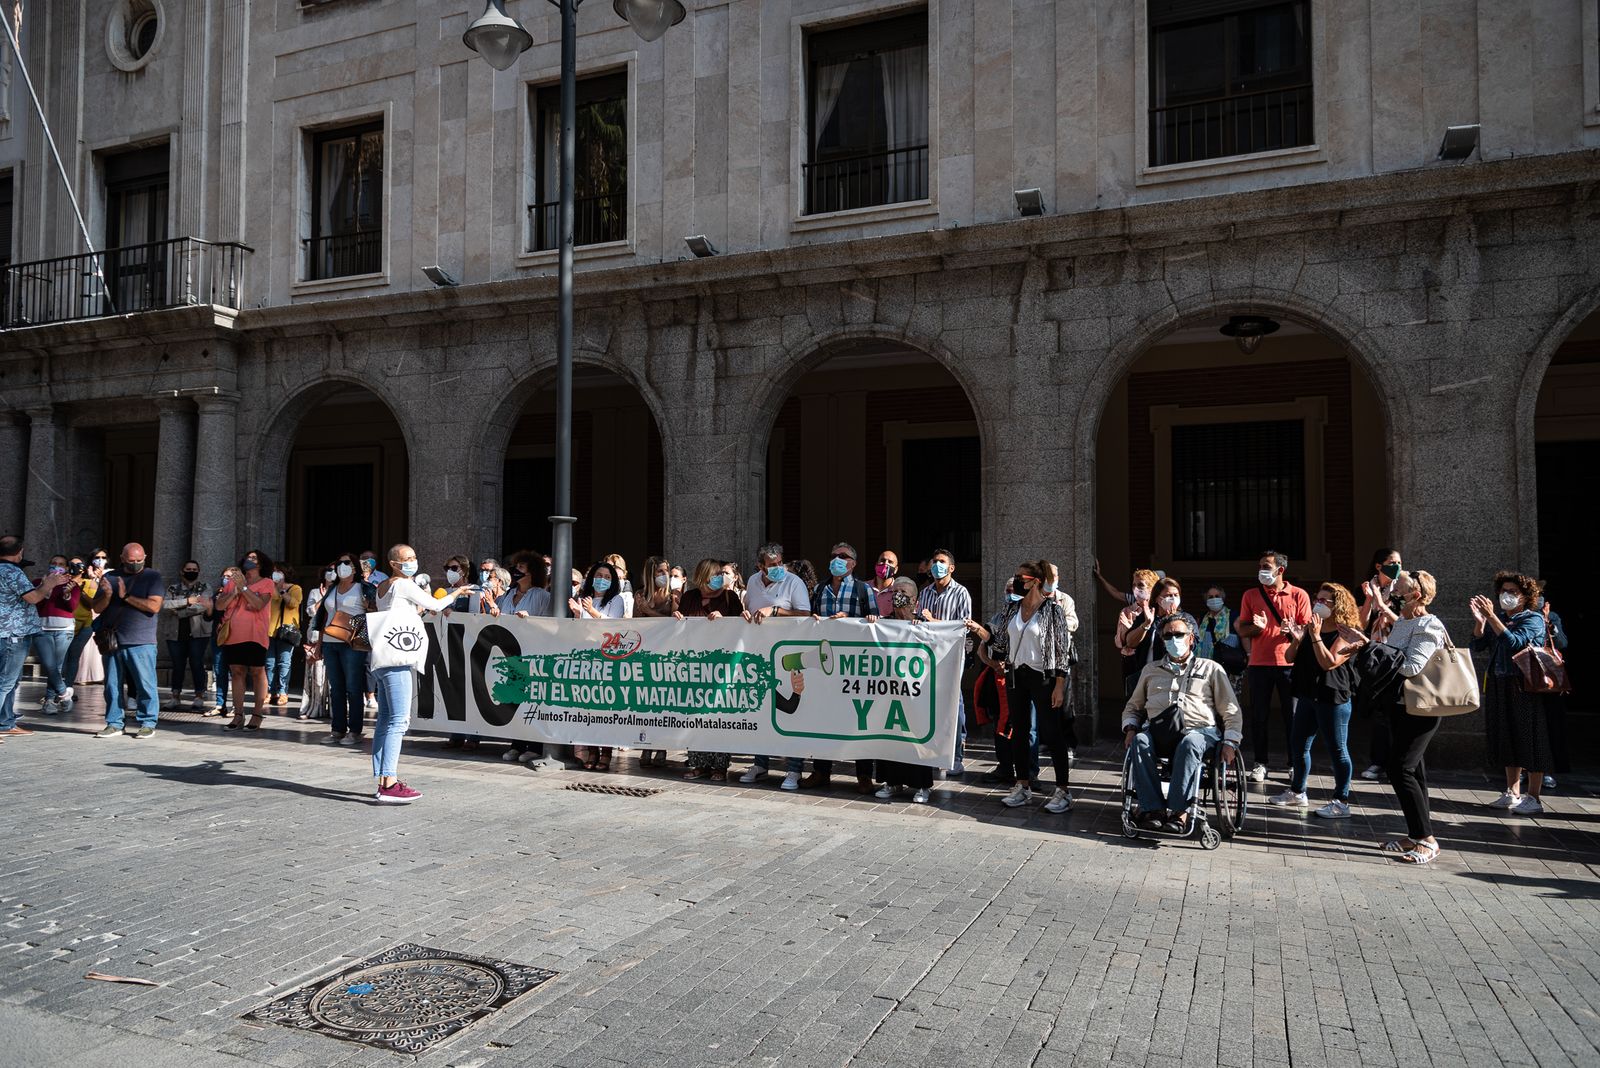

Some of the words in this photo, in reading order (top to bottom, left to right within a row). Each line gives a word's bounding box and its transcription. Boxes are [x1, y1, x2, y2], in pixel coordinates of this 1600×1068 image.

[602, 632, 621, 649] 24
[417, 622, 522, 726] NO
[529, 659, 549, 677] AL
[553, 659, 614, 681] CIERRE
[619, 662, 644, 682] DE
[650, 662, 759, 684] URGENCIAS
[839, 649, 925, 679] MÉDICO
[530, 681, 547, 700] EN
[551, 682, 569, 702] EL
[571, 681, 616, 705] ROCÍO
[620, 686, 631, 705] Y
[636, 683, 759, 709] MATALASCAÑAS
[842, 679, 861, 694] 24
[867, 680, 921, 697] HORAS
